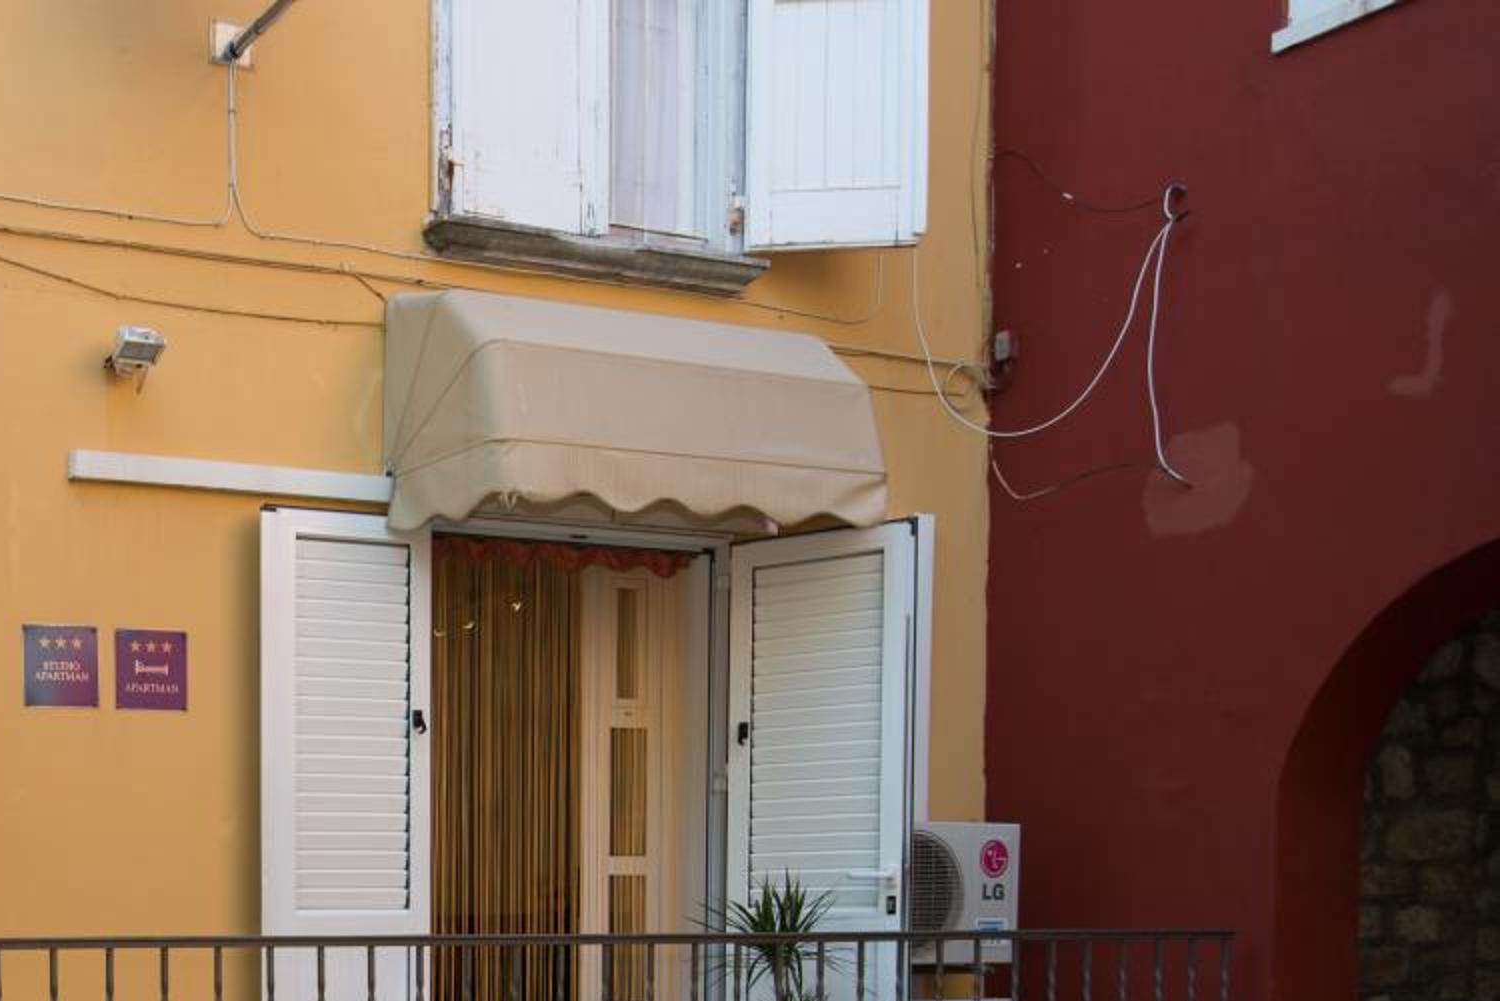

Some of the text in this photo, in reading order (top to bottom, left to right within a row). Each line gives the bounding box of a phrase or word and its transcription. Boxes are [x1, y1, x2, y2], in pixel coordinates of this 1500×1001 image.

[35, 671, 90, 681] APARTMAN
[125, 683, 180, 694] APARTMAN
[982, 883, 1005, 901] LG
